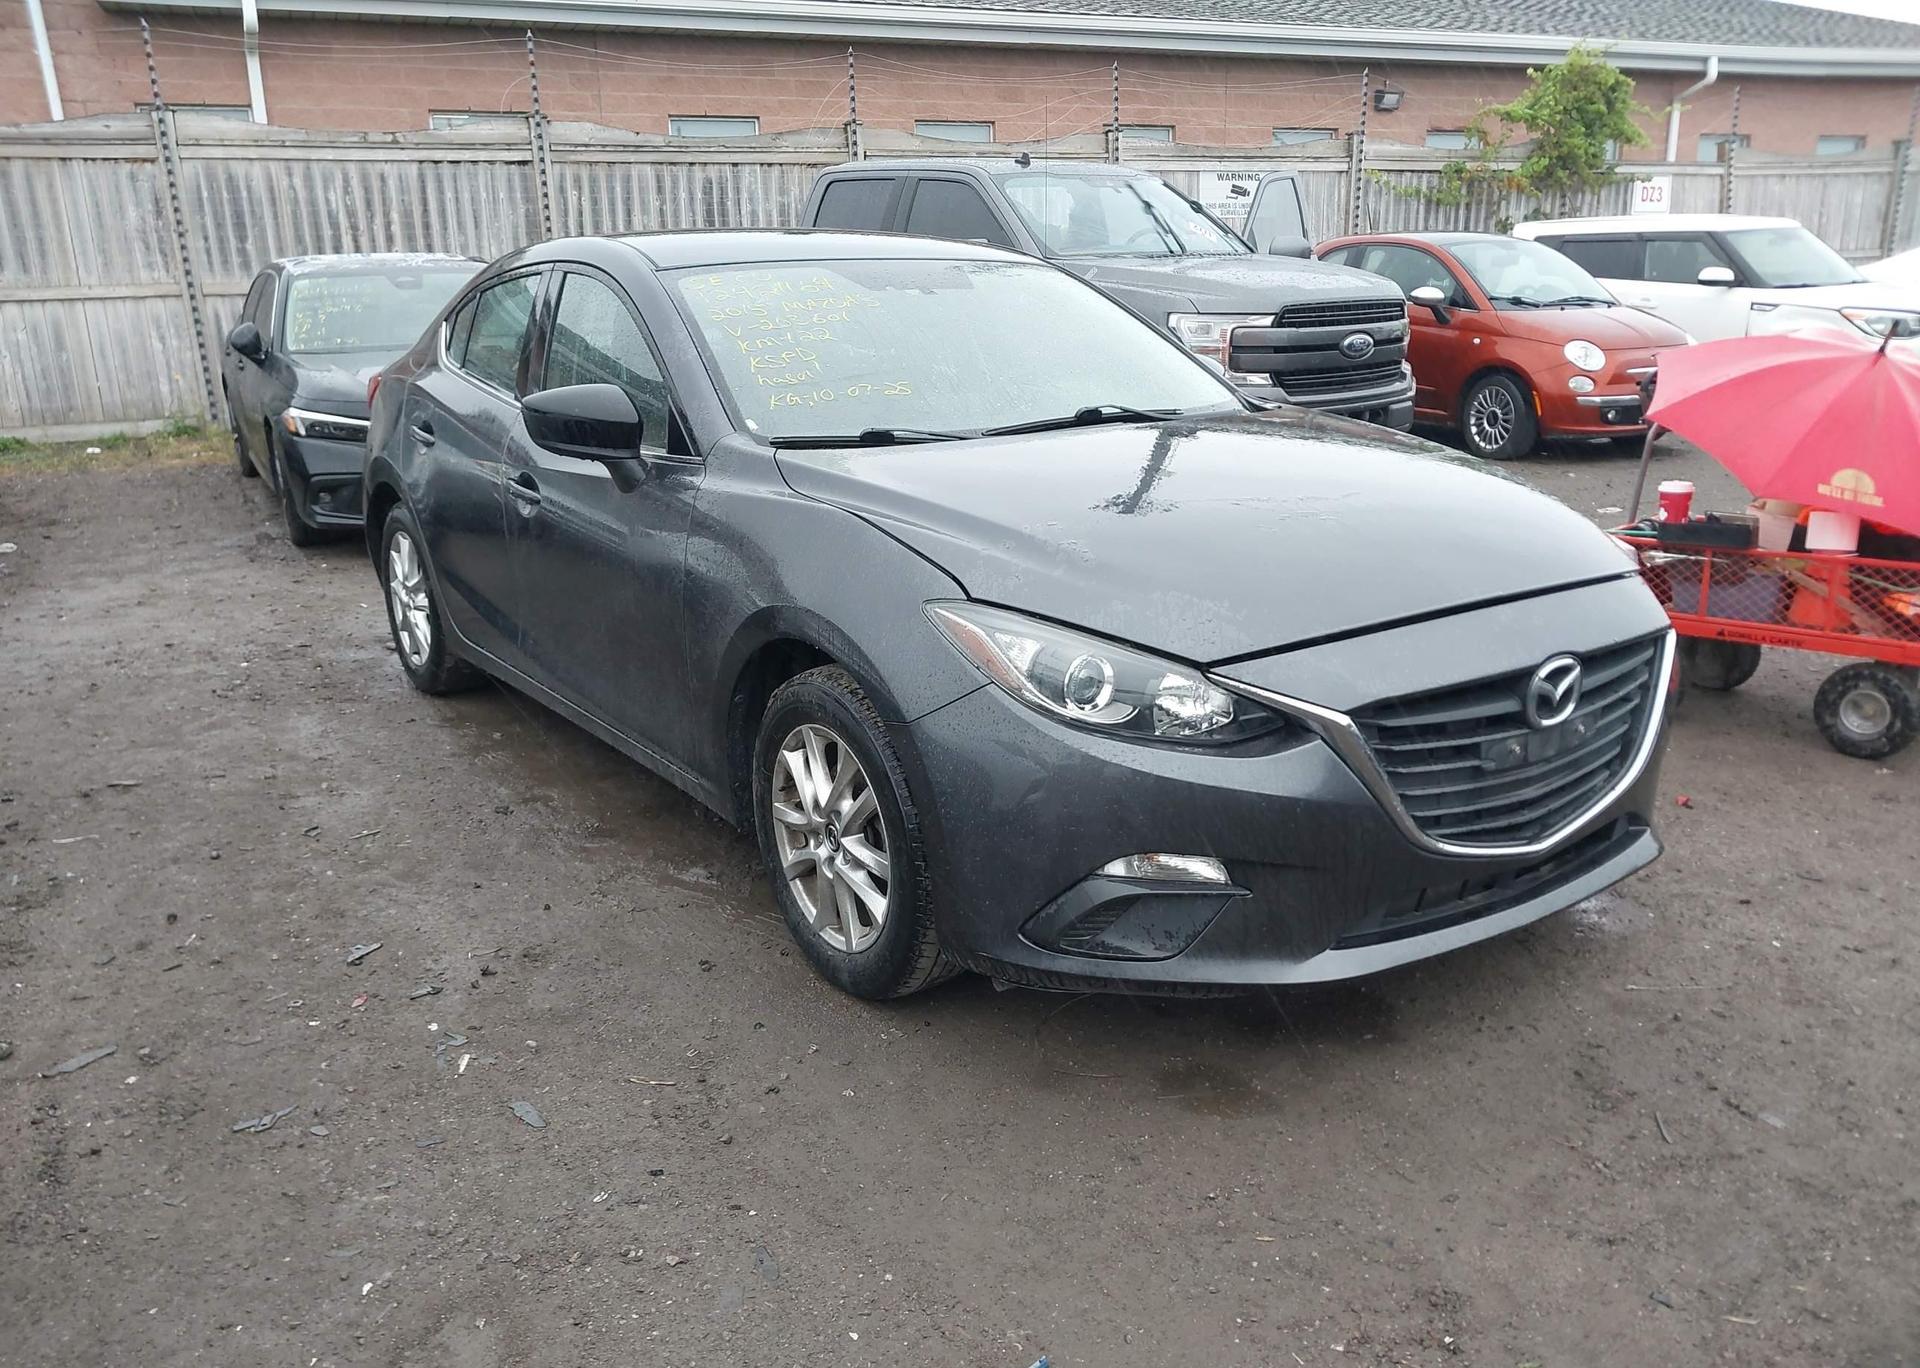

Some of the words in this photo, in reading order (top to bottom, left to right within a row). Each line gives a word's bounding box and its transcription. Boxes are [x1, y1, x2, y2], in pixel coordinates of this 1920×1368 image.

[1216, 173, 1261, 182] WARNING
[1641, 186, 1663, 203] DZ3
[707, 303, 768, 321] 2015
